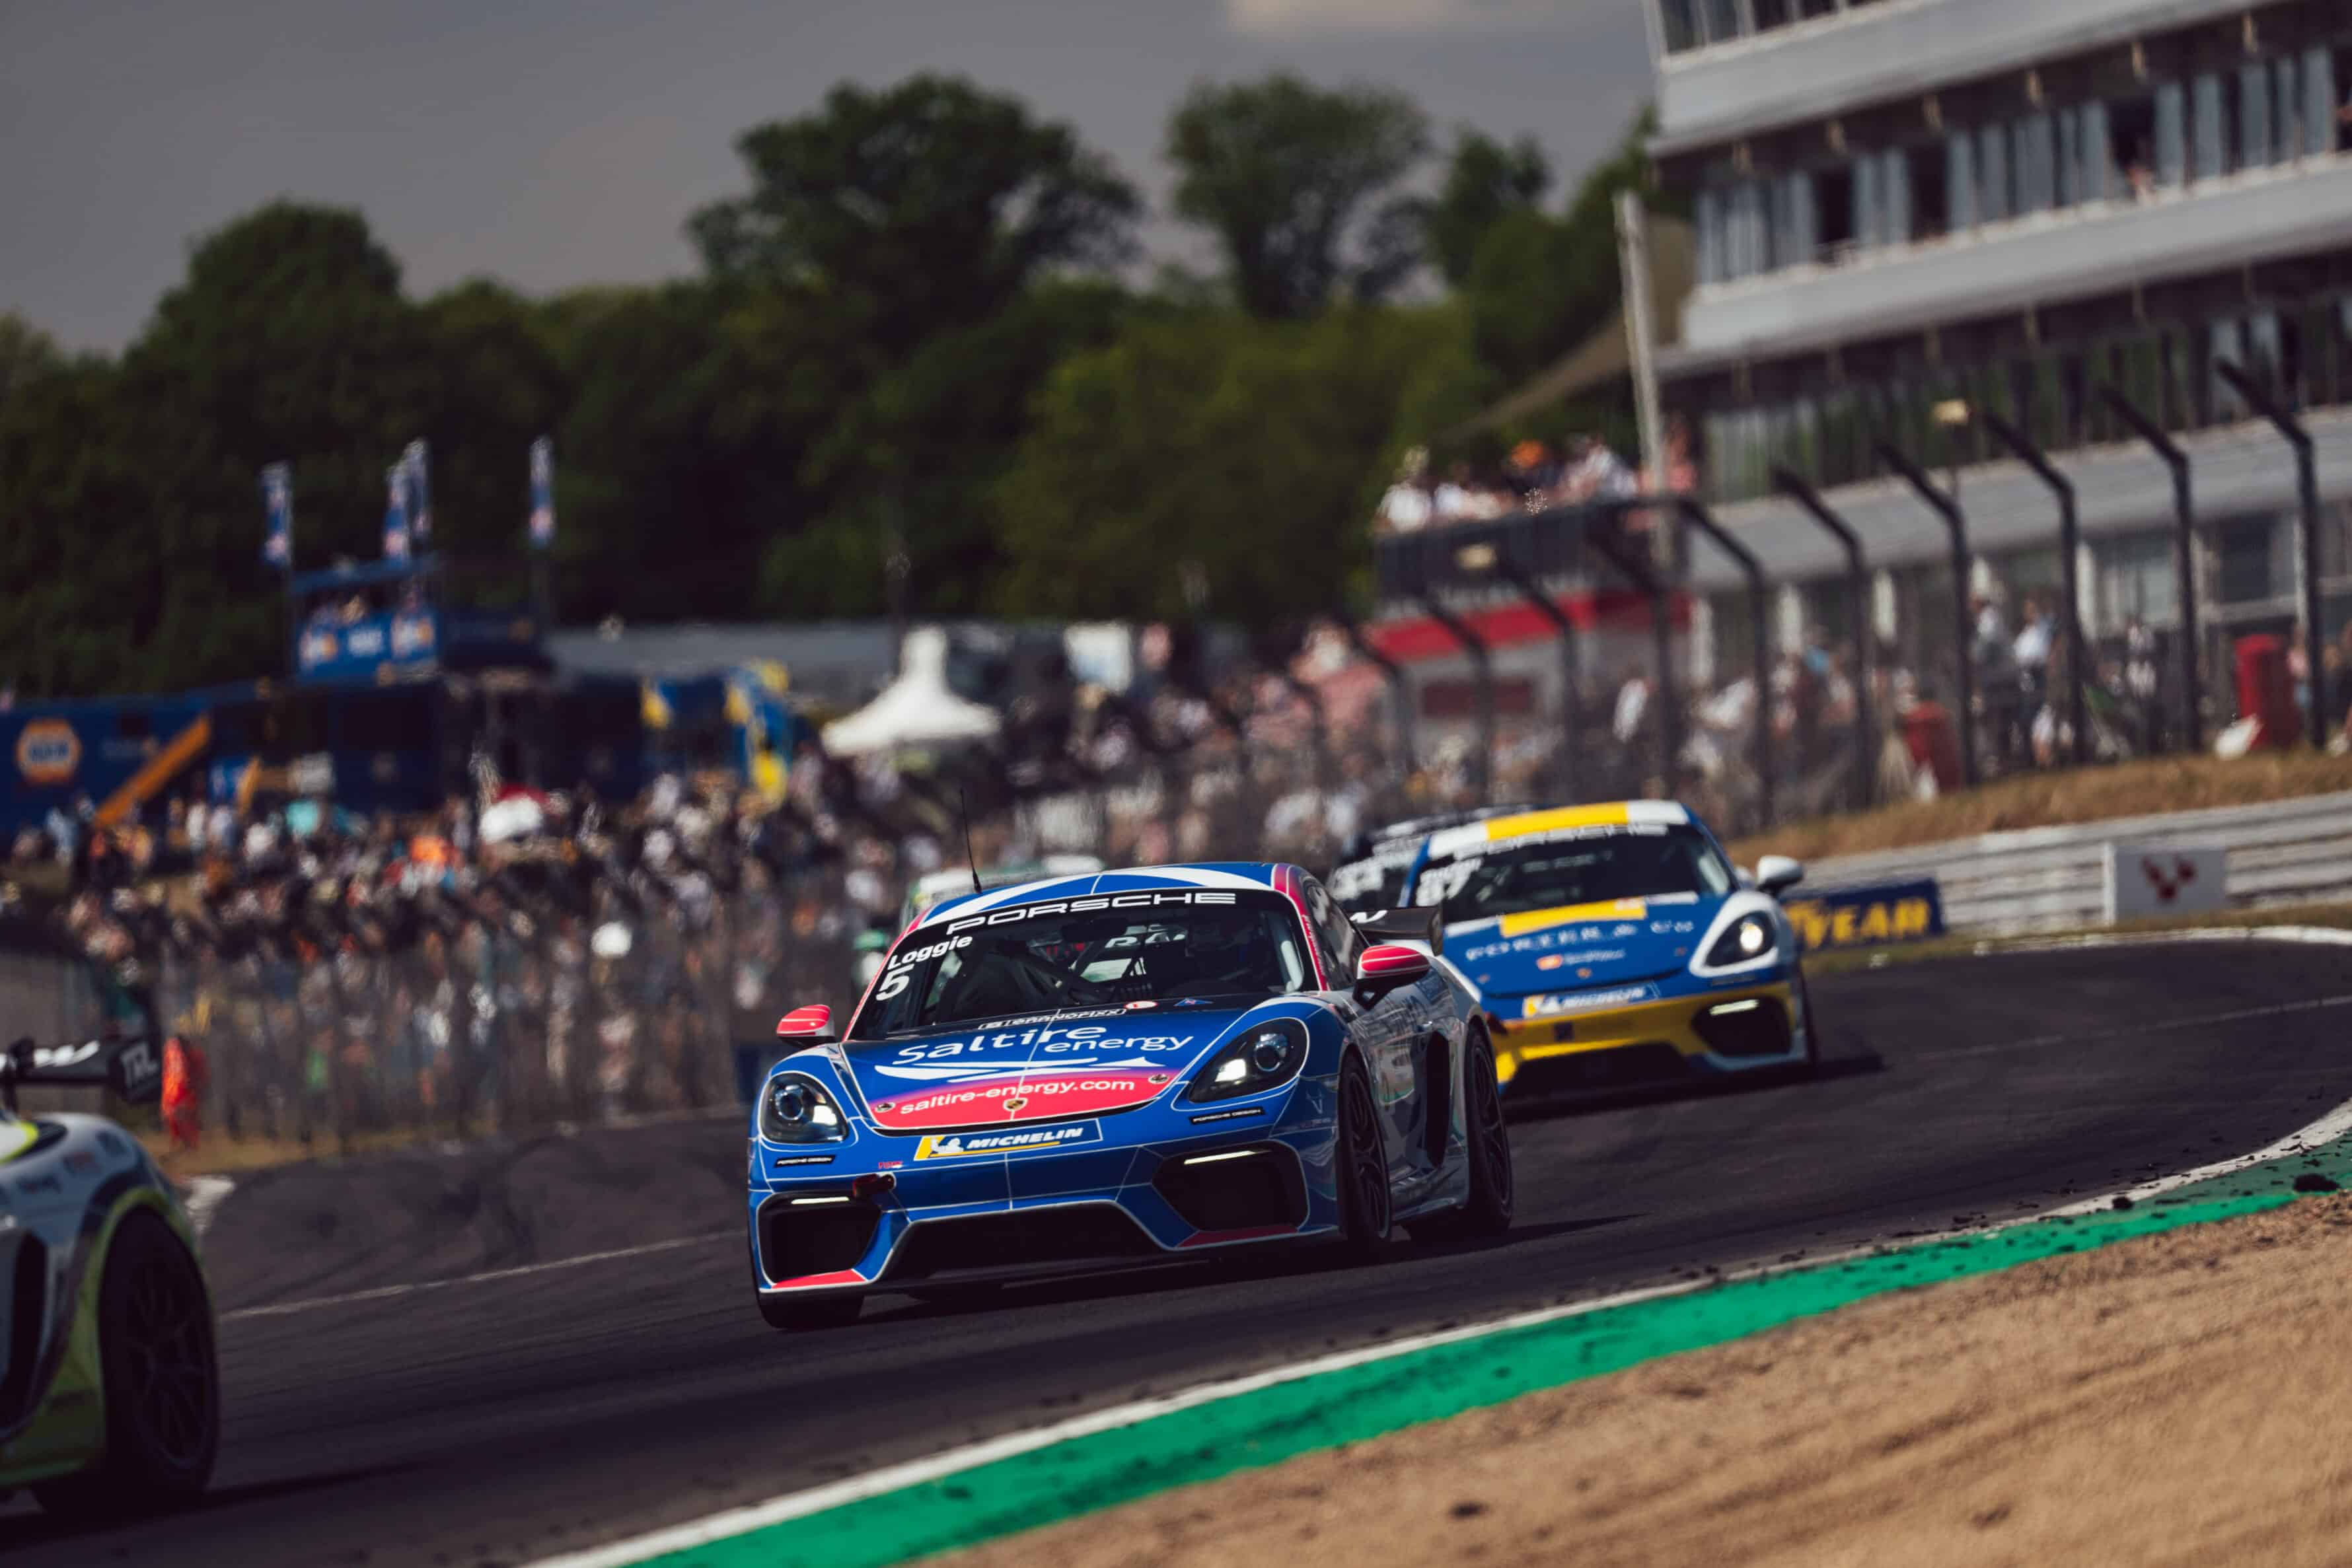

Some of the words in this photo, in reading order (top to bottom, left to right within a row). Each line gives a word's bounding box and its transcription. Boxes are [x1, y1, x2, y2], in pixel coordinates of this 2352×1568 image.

[946, 893, 1236, 935] PORSCHE
[887, 935, 973, 970] Loggie
[875, 964, 915, 1001] 5
[1044, 1036, 1194, 1052] energy
[900, 1079, 1135, 1115] saltire-energy.com
[967, 1127, 1084, 1149] MICHELIN
